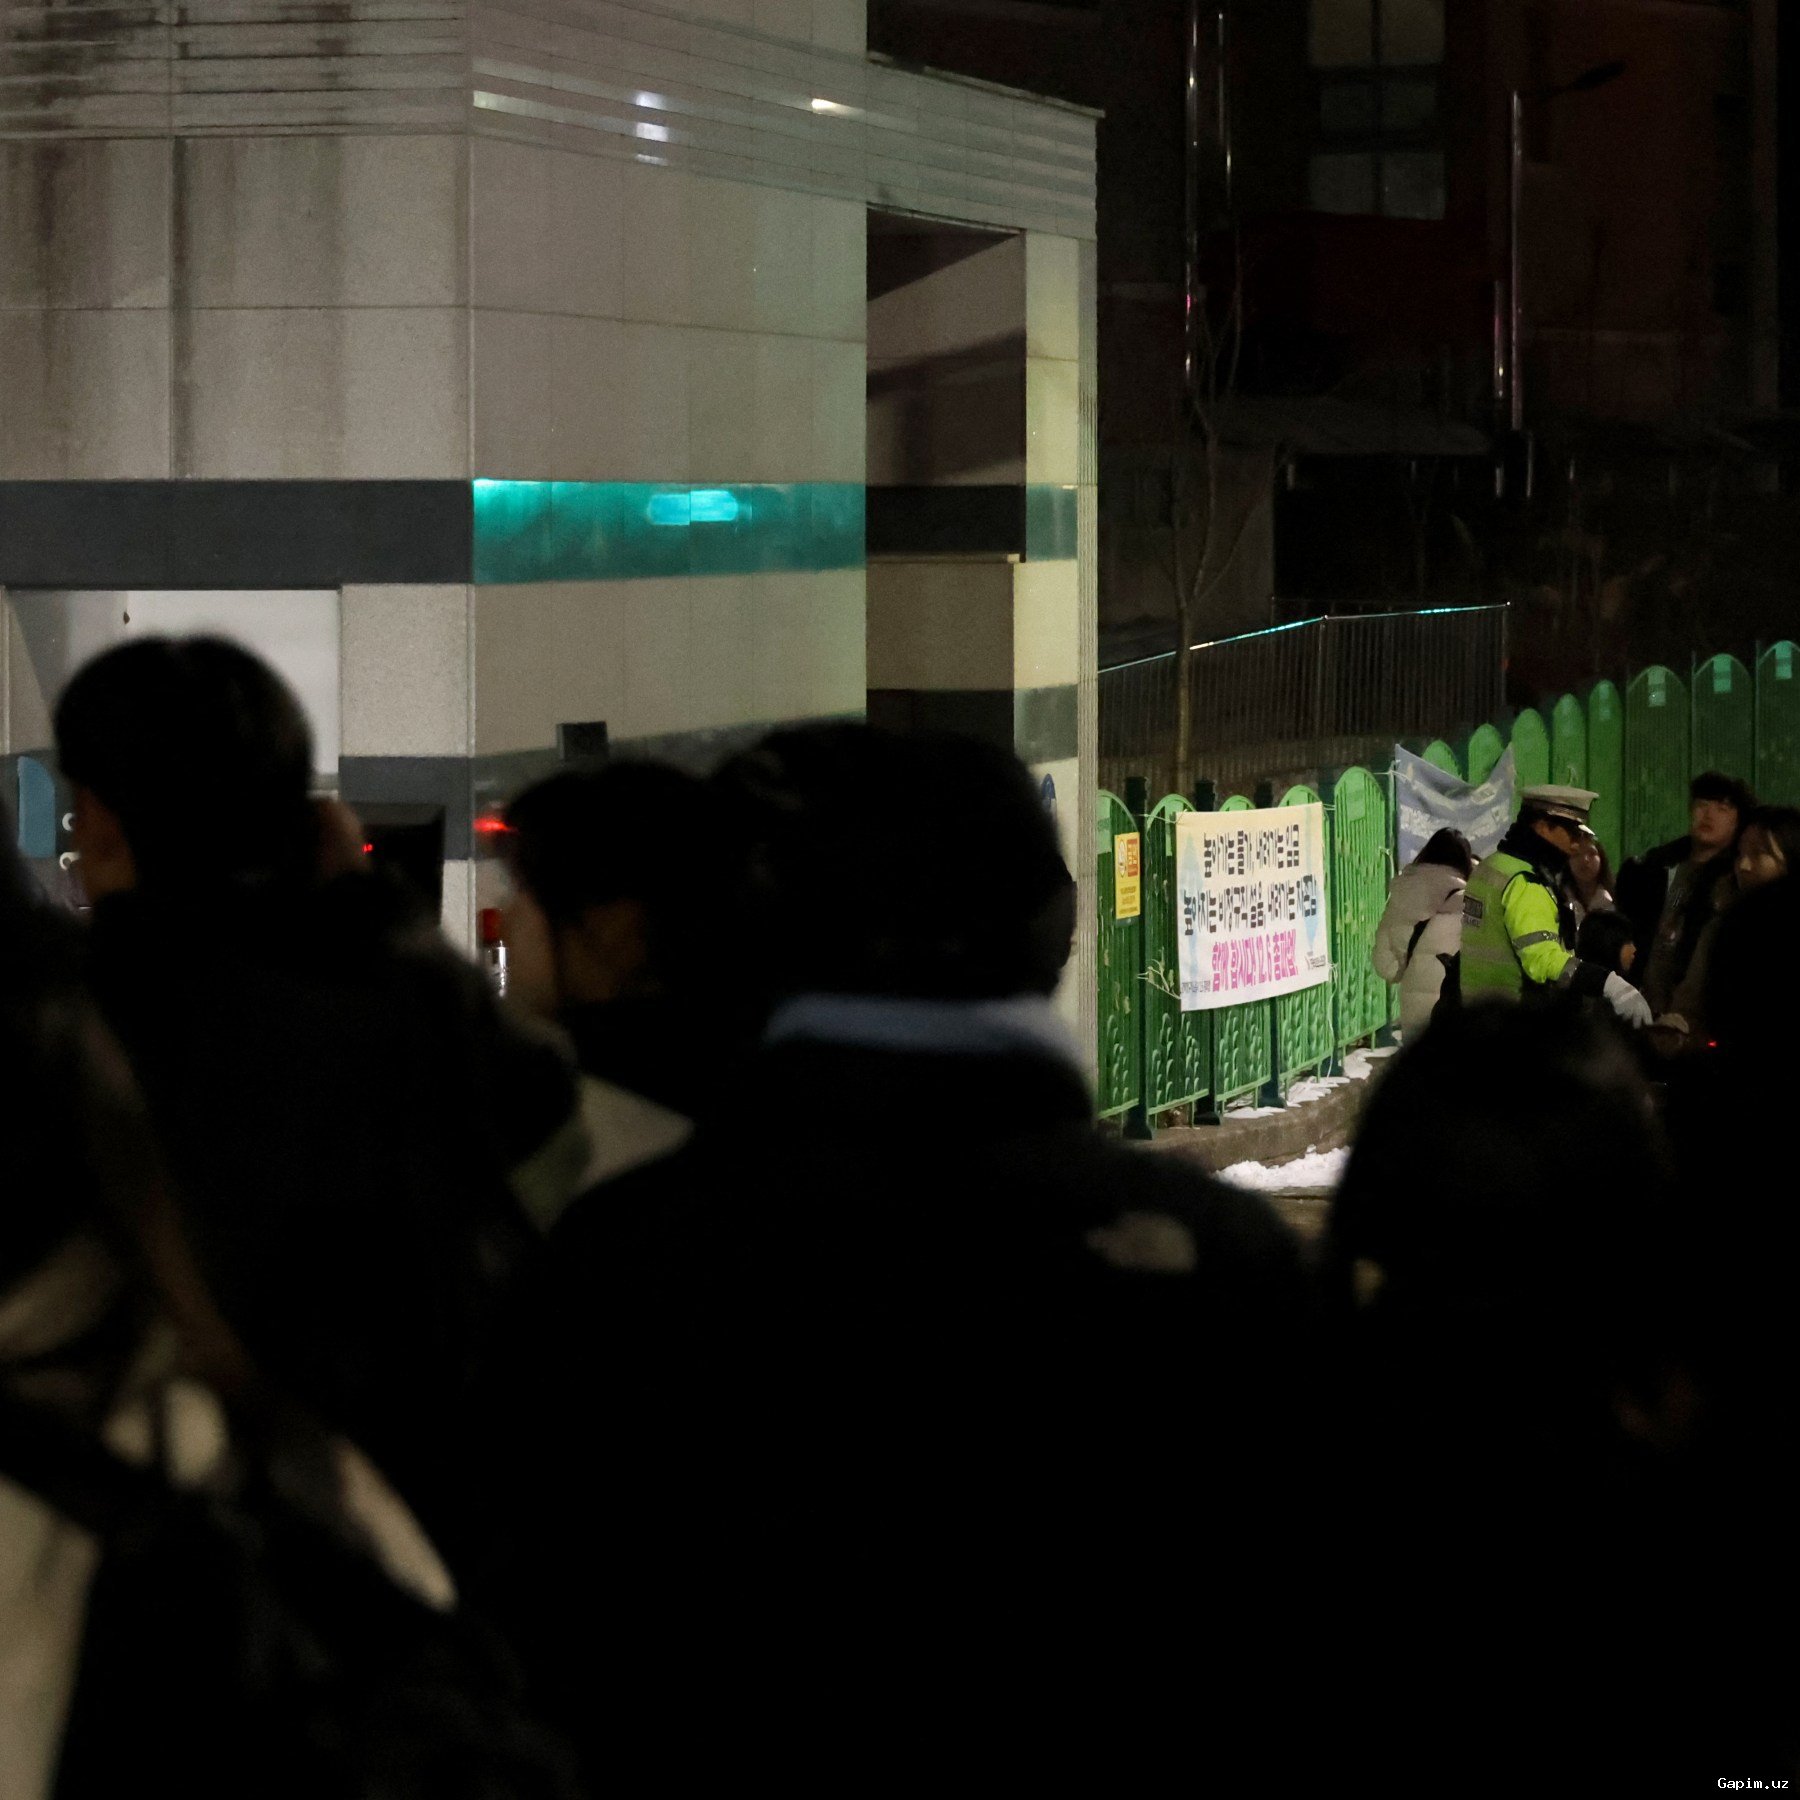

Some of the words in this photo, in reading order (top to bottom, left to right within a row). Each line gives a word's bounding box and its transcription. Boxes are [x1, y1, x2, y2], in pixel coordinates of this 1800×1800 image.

[1204, 832, 1235, 878] 높아가는
[1256, 828, 1284, 870] 내려가는
[1286, 823, 1299, 868] 임금
[1184, 889, 1216, 935] 높아지는
[1219, 886, 1248, 933] 비정규직
[1268, 879, 1295, 921] 내려가는
[1212, 941, 1229, 992] 함께
